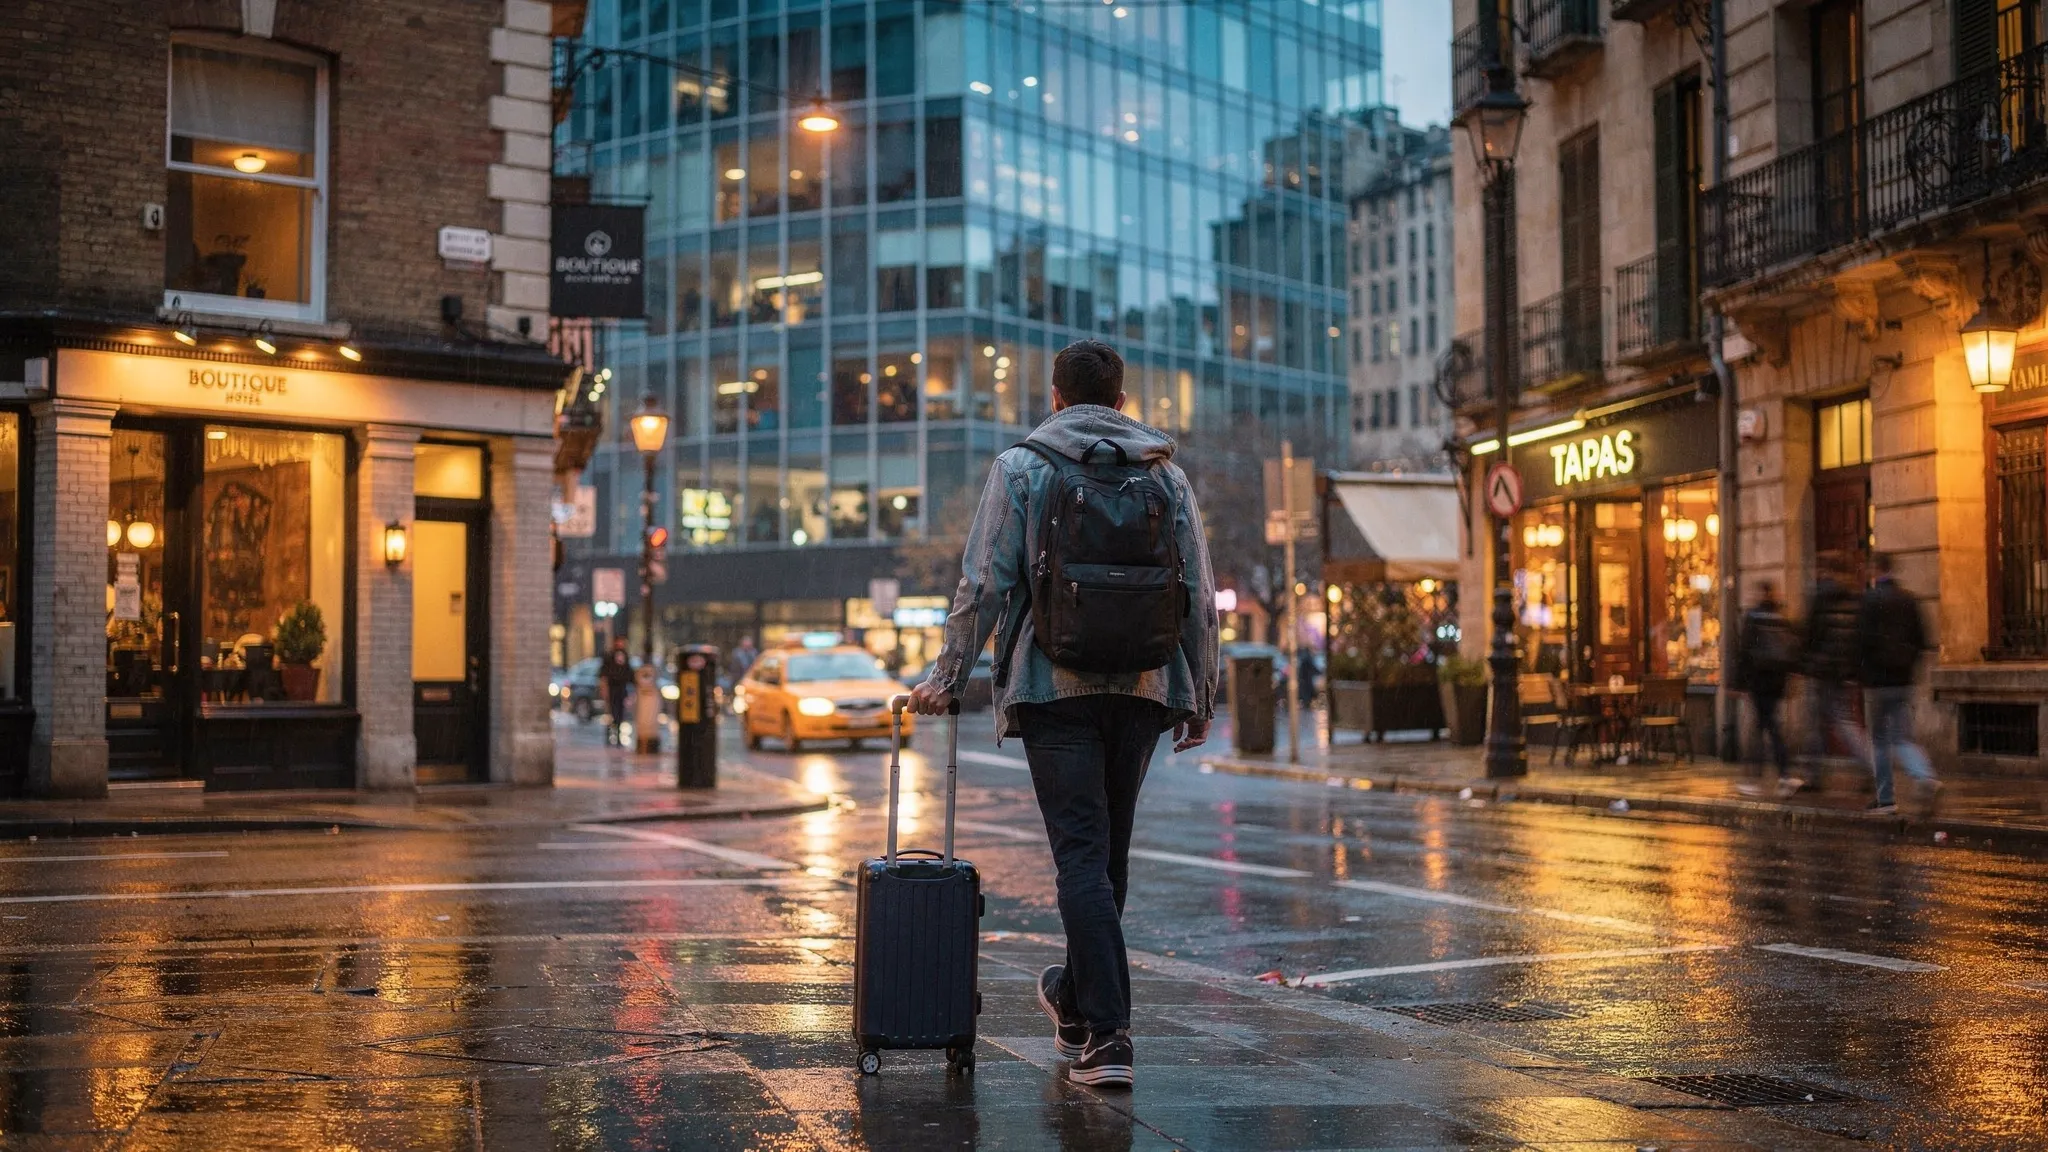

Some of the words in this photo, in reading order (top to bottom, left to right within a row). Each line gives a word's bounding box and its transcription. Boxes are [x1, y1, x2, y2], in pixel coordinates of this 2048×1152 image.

[555, 256, 641, 275] BOUTIQUE
[189, 369, 287, 393] BOUTIQUE
[1550, 430, 1634, 486] TAPAS
